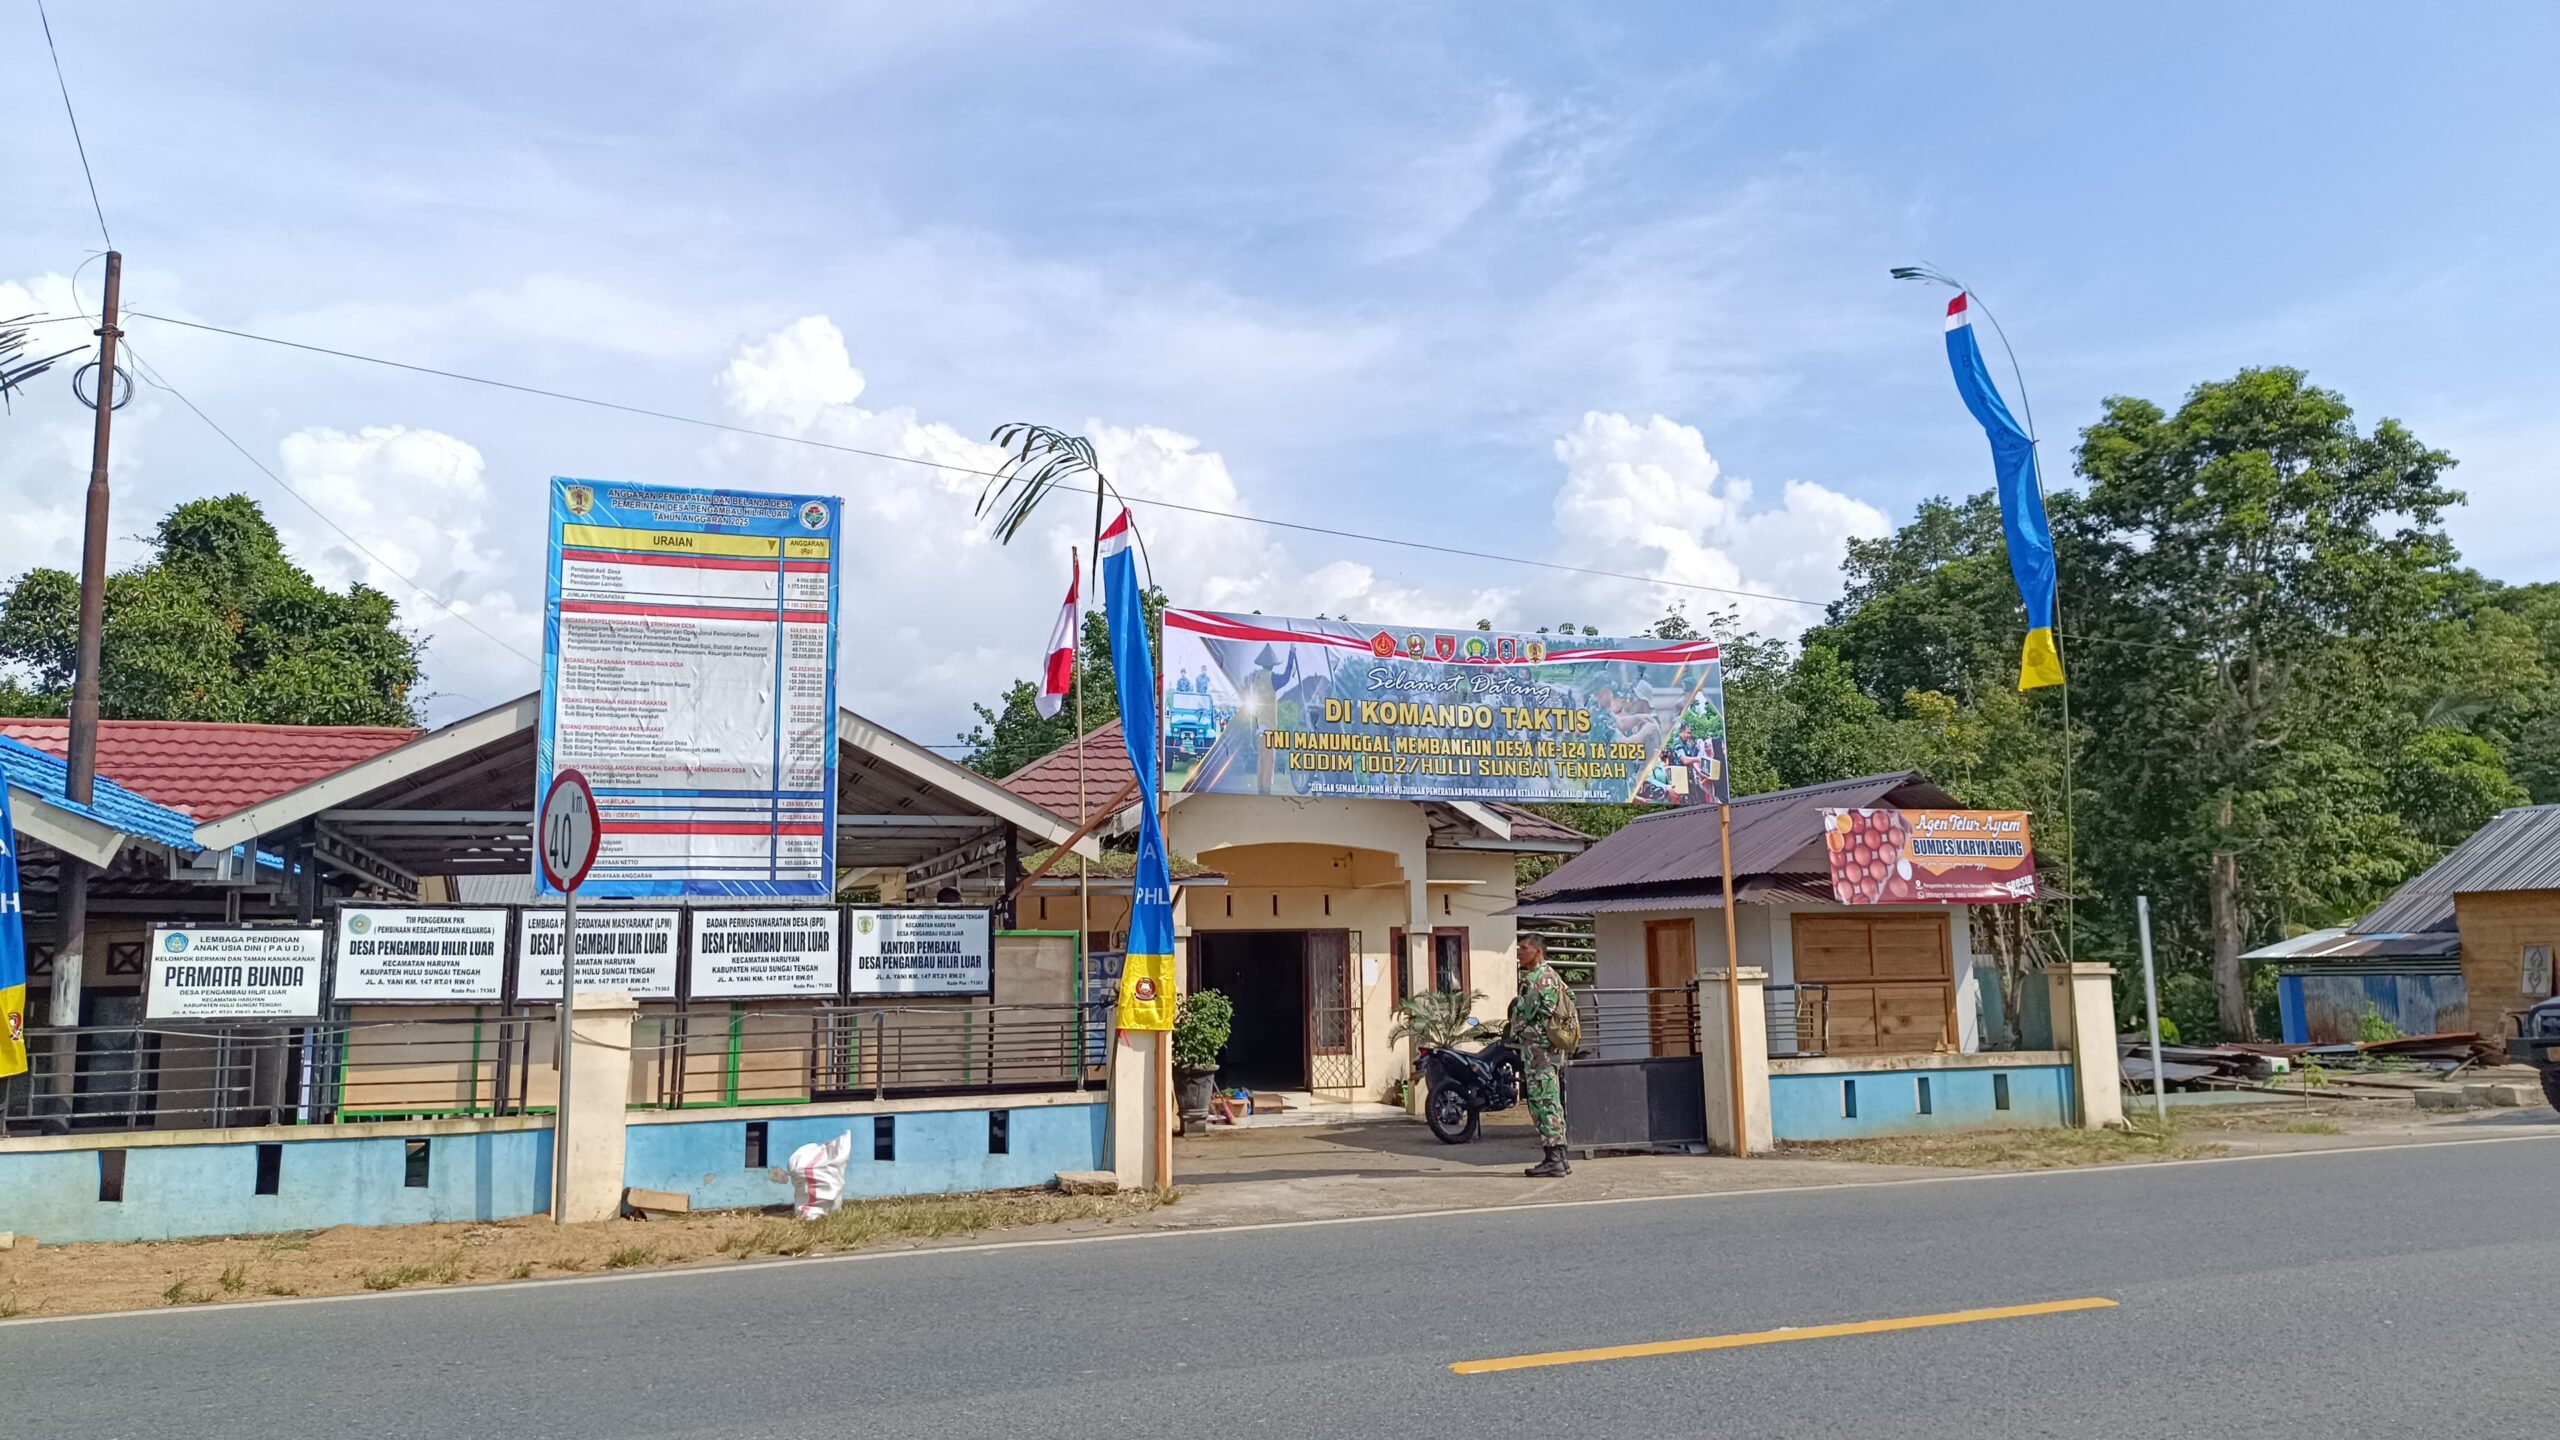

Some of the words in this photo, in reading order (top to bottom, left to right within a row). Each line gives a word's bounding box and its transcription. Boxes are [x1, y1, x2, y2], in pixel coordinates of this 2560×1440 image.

[608, 489, 656, 499] ANGGARAN
[658, 492, 711, 503] PENDAPATAN
[713, 496, 729, 504] DAN
[732, 497, 769, 507] BELANJA
[771, 500, 792, 508] DESA
[612, 500, 665, 510] PEMERINTAH
[667, 503, 689, 512] DESA
[691, 505, 741, 515] PENGAMBAU
[767, 509, 788, 518] LUAR
[654, 512, 680, 521] TAHUN
[682, 514, 729, 525] ANGGARAN
[731, 518, 748, 526] 2025
[653, 536, 693, 548] URAIAN
[790, 540, 824, 548] ANGGARAN
[1366, 667, 1464, 694] Selamat
[1471, 674, 1552, 703] Datang
[1325, 698, 1350, 723] DI
[1361, 701, 1492, 729] KOMANDO
[1501, 707, 1591, 733] TAKTIS
[1264, 730, 1290, 749] TNI
[1294, 732, 1391, 753] MANUNGGAL
[1396, 736, 1492, 757] MEMBANGUN
[1496, 740, 1534, 758] DESA
[1537, 741, 1586, 760] KE-124
[1590, 743, 1607, 760] TA
[1610, 743, 1646, 761] 2025
[1289, 752, 1353, 772] KODIM
[1360, 754, 1472, 776] 1002/HULU
[1479, 758, 1549, 778] SUNGAI
[1557, 761, 1626, 779] TENGAH
[572, 791, 582, 814] km
[1915, 814, 1949, 837] Agen
[1950, 814, 1980, 832] Telur
[1982, 816, 2021, 837] Ayam
[550, 813, 571, 869] 40
[1912, 839, 1954, 855] BUMDES
[1956, 840, 1988, 855] KARYA
[1989, 841, 2023, 856] AGUNG
[528, 919, 559, 929] LEMBAGA
[612, 918, 653, 928] MASYARAKAT
[655, 918, 672, 930] (LPM)
[707, 918, 727, 928] BADAN
[729, 918, 791, 928] PERMUSYAWARATAN
[793, 918, 808, 927] DESA
[810, 917, 825, 929] (BPD)
[350, 940, 375, 955] DESA
[378, 941, 439, 955] PENGAMBAU
[441, 941, 468, 955] HILIR
[470, 941, 494, 956] LUAR
[530, 933, 557, 955] DESA
[557, 933, 616, 955] PGAMBAU
[618, 933, 642, 954] HILIR
[644, 933, 667, 954] LUAR
[702, 933, 724, 953] DESA
[727, 932, 781, 953] PENGAMBAU
[783, 932, 805, 952] HILIR
[807, 931, 829, 952] LUAR
[881, 941, 915, 954] KANTOR
[917, 941, 961, 954] PEMBAKAL
[859, 957, 881, 969] DESA
[883, 956, 935, 969] PENGAMBAU
[937, 956, 959, 969] HILIR
[961, 955, 981, 968] LUAR
[165, 966, 242, 987] PERMATA
[248, 966, 304, 987] BUNDA
